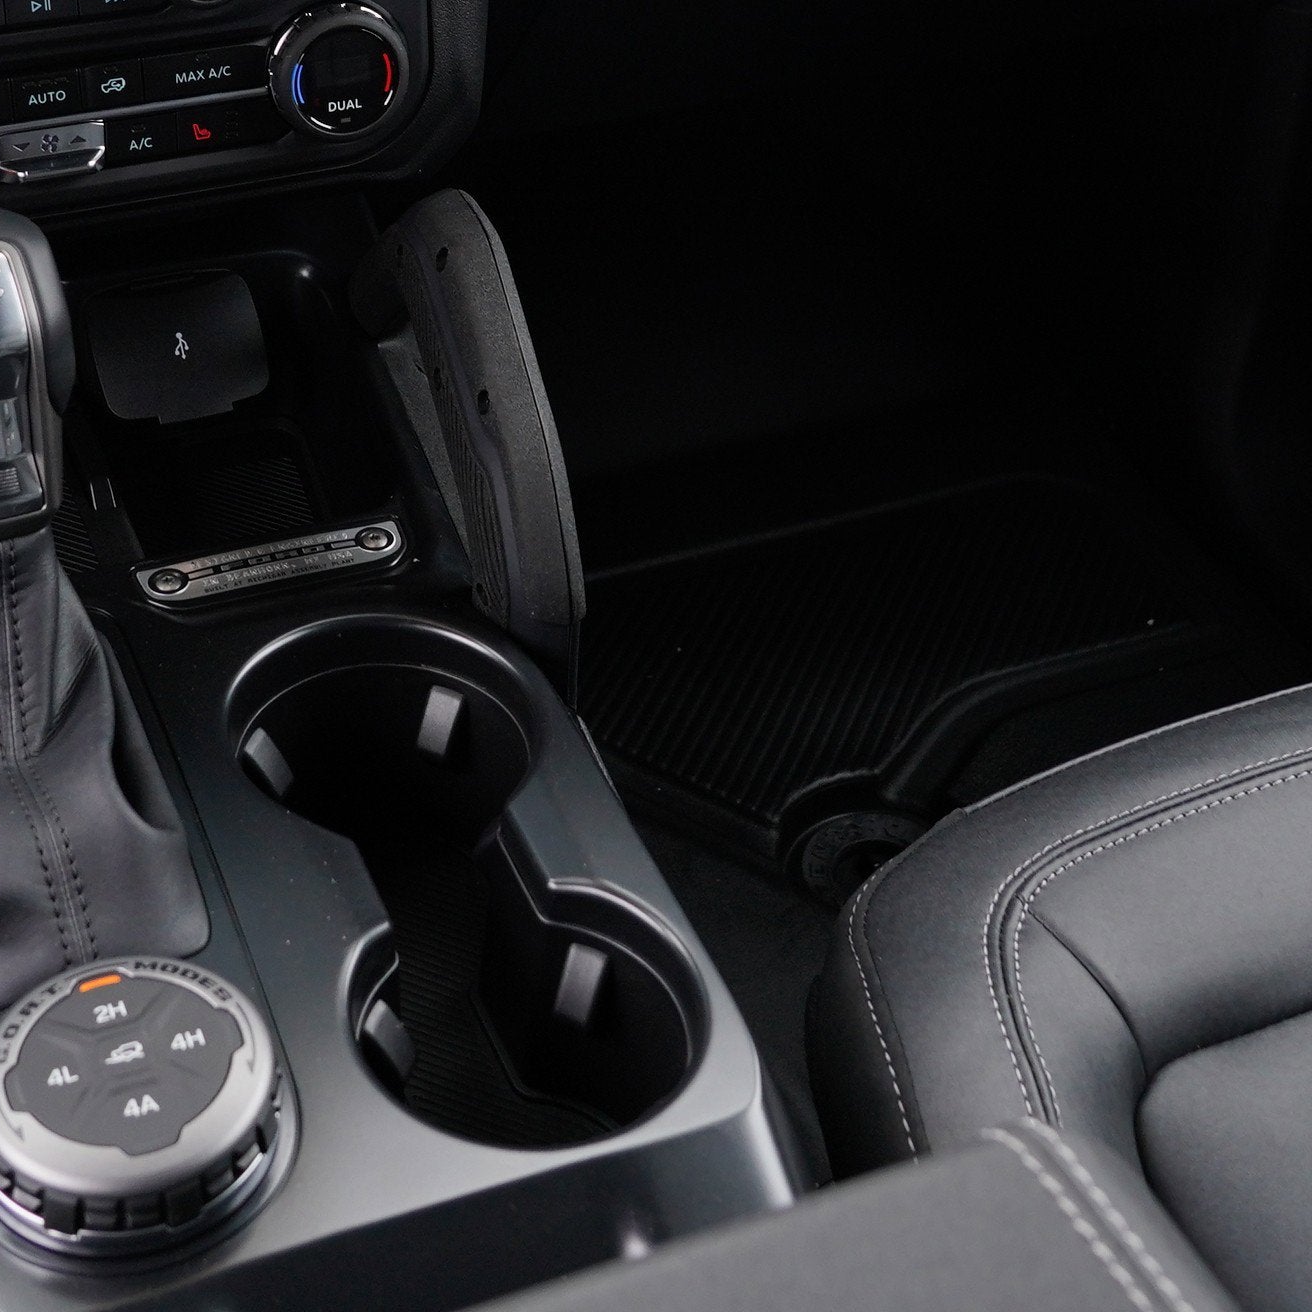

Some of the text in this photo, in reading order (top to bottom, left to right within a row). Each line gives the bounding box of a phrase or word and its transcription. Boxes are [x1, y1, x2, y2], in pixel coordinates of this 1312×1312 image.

[175, 65, 233, 85] MAX A/C
[28, 90, 66, 106] AUTO
[328, 98, 363, 113] DUAL
[129, 136, 153, 151] A/C
[134, 960, 233, 1002] MODES
[92, 999, 128, 1024] 2H
[170, 1027, 207, 1051] 4H
[47, 1065, 80, 1087] 4L
[123, 1094, 160, 1118] 4A
